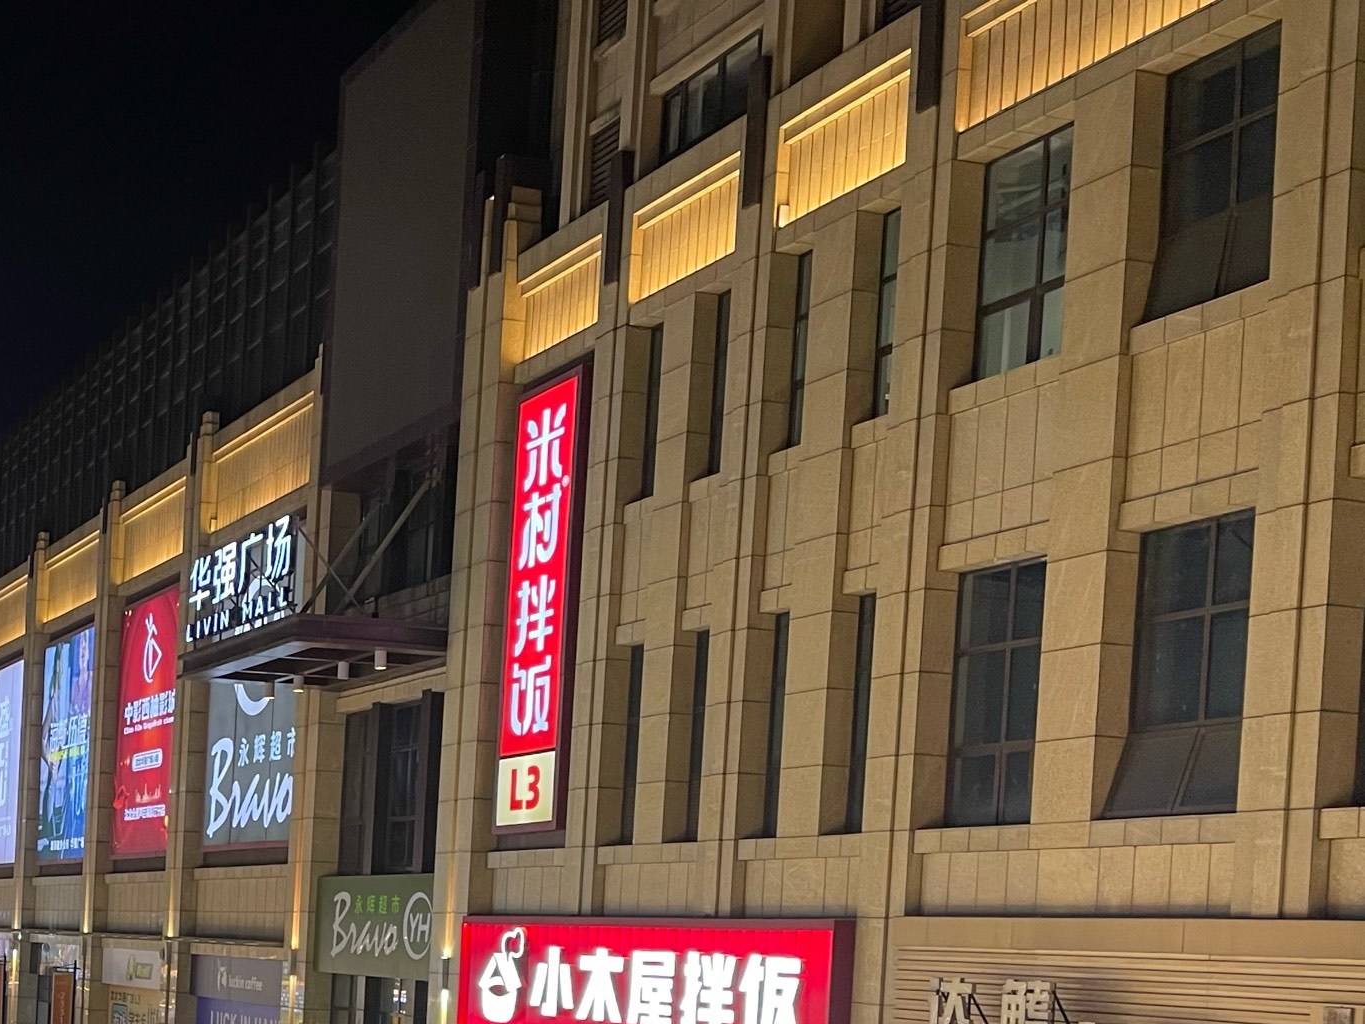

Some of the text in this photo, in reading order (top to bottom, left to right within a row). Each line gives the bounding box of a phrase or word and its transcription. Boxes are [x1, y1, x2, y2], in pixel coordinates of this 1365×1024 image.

[188, 514, 292, 611] 华强广场
[510, 402, 566, 736] 米村拌饭
[186, 588, 288, 643] LIVIN MALL
[206, 737, 293, 838] Bravo
[509, 765, 540, 812] L3
[331, 892, 431, 957] Bravo YH
